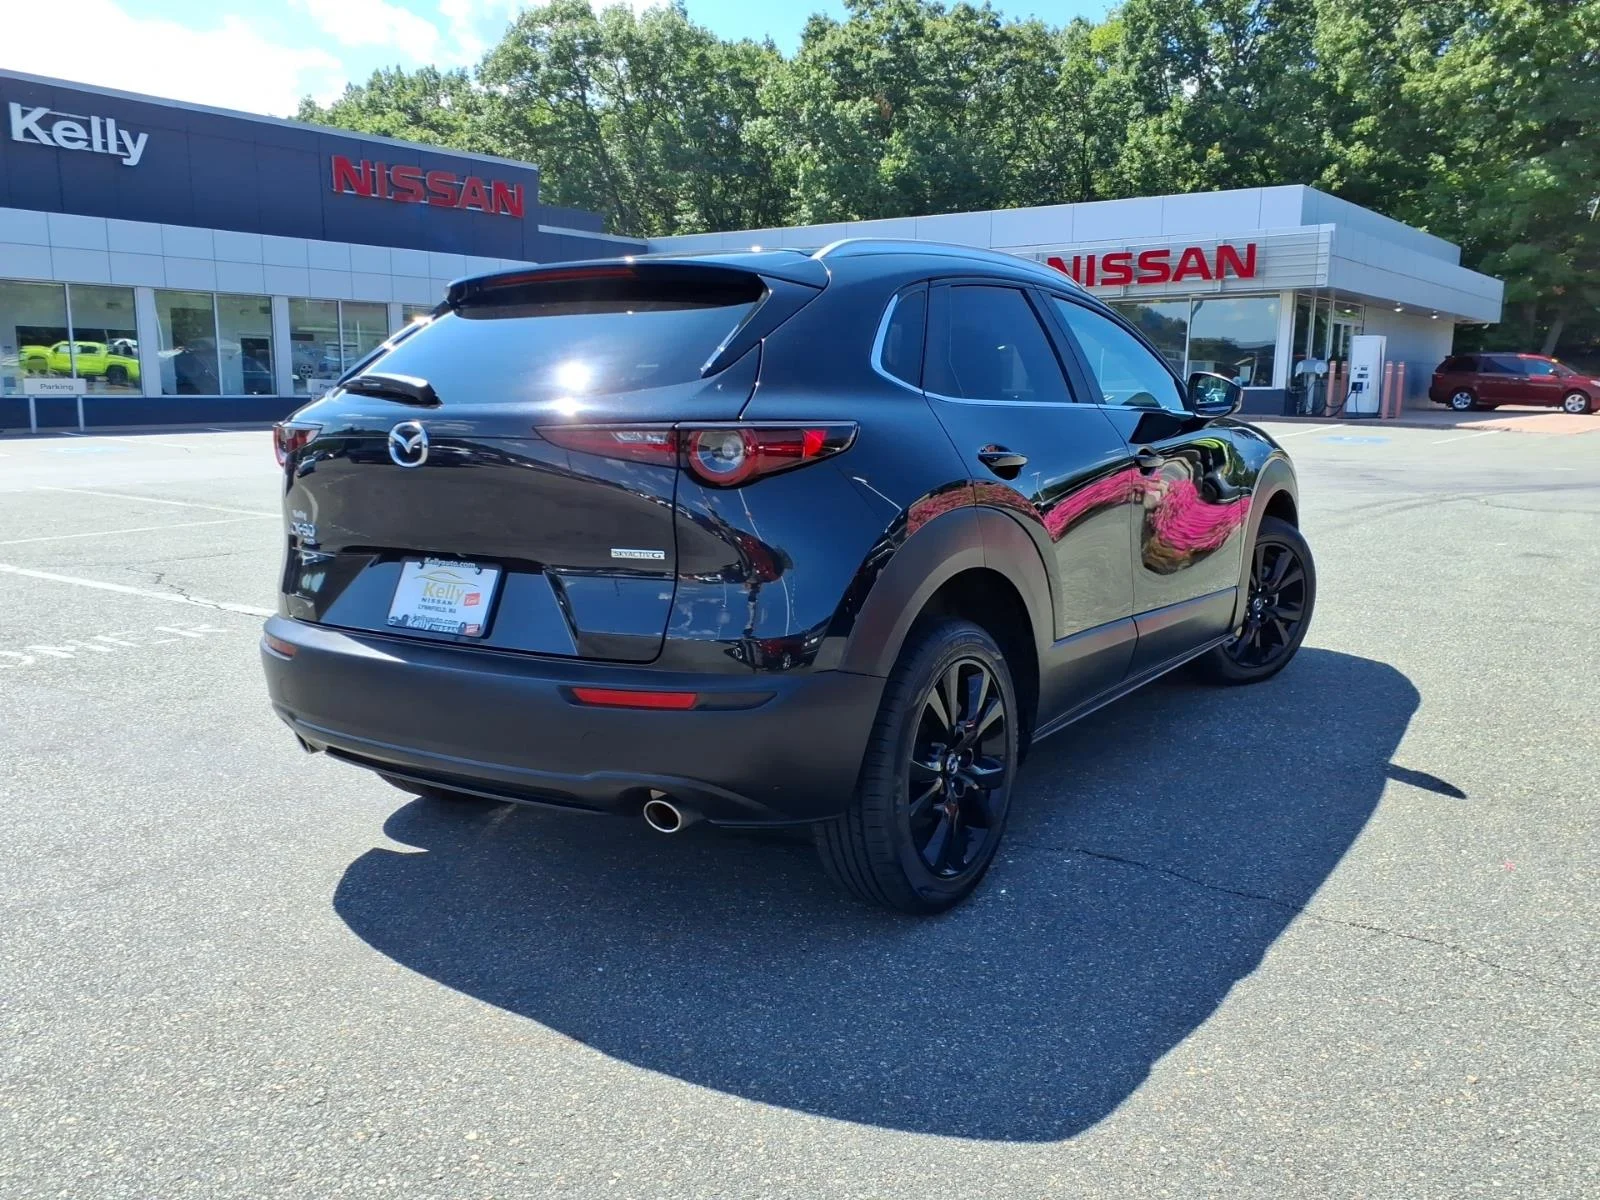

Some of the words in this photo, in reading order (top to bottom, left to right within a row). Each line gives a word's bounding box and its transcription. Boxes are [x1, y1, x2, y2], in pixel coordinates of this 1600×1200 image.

[9, 102, 148, 166] Kelly
[331, 154, 524, 218] NISSAN
[1047, 243, 1257, 288] NISSAN
[40, 383, 74, 391] Parking
[423, 582, 464, 605] Kelly
